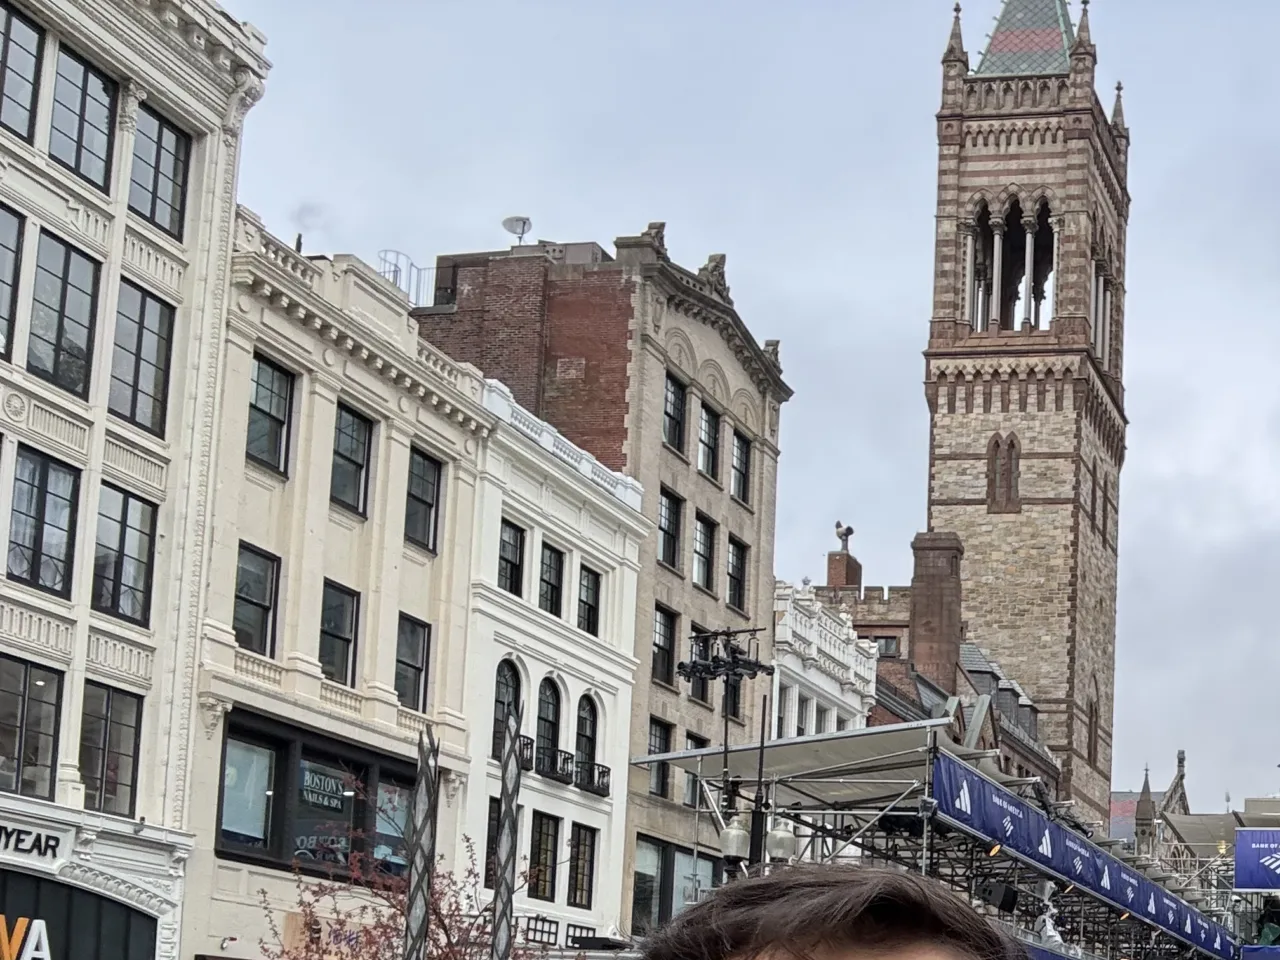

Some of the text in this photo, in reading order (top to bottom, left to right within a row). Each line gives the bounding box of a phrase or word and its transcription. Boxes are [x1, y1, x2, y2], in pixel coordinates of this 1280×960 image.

[304, 772, 343, 795] BOSTON'S
[304, 790, 342, 809] NAILS & SPA
[0, 825, 60, 859] YEAR
